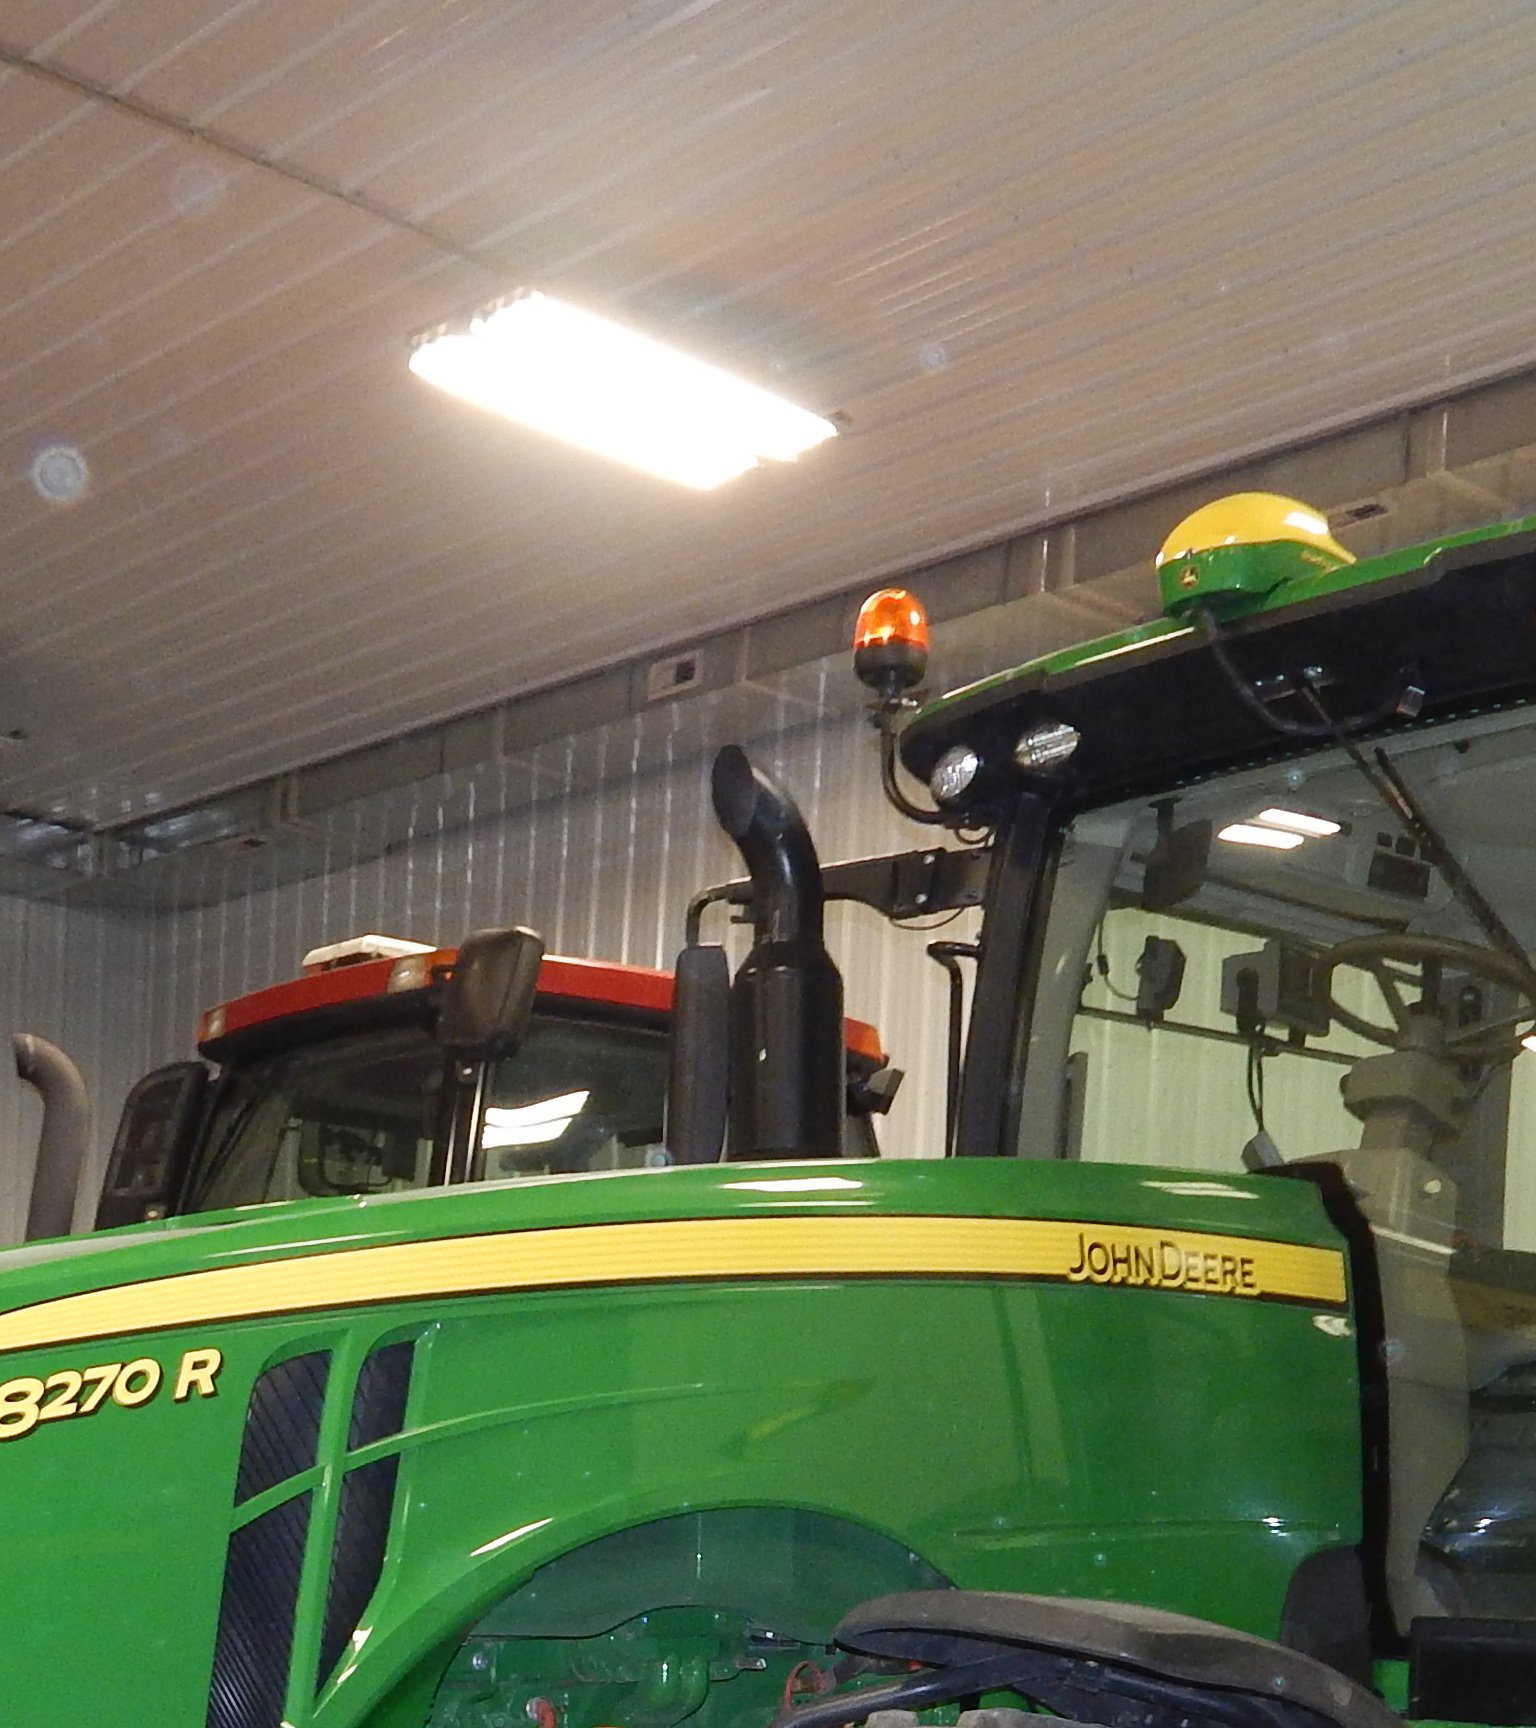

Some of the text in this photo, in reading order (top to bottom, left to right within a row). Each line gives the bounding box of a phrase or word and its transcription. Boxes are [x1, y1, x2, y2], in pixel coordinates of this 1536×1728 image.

[1068, 1232, 1259, 1294] JOHN DEERE
[174, 1347, 223, 1402] R
